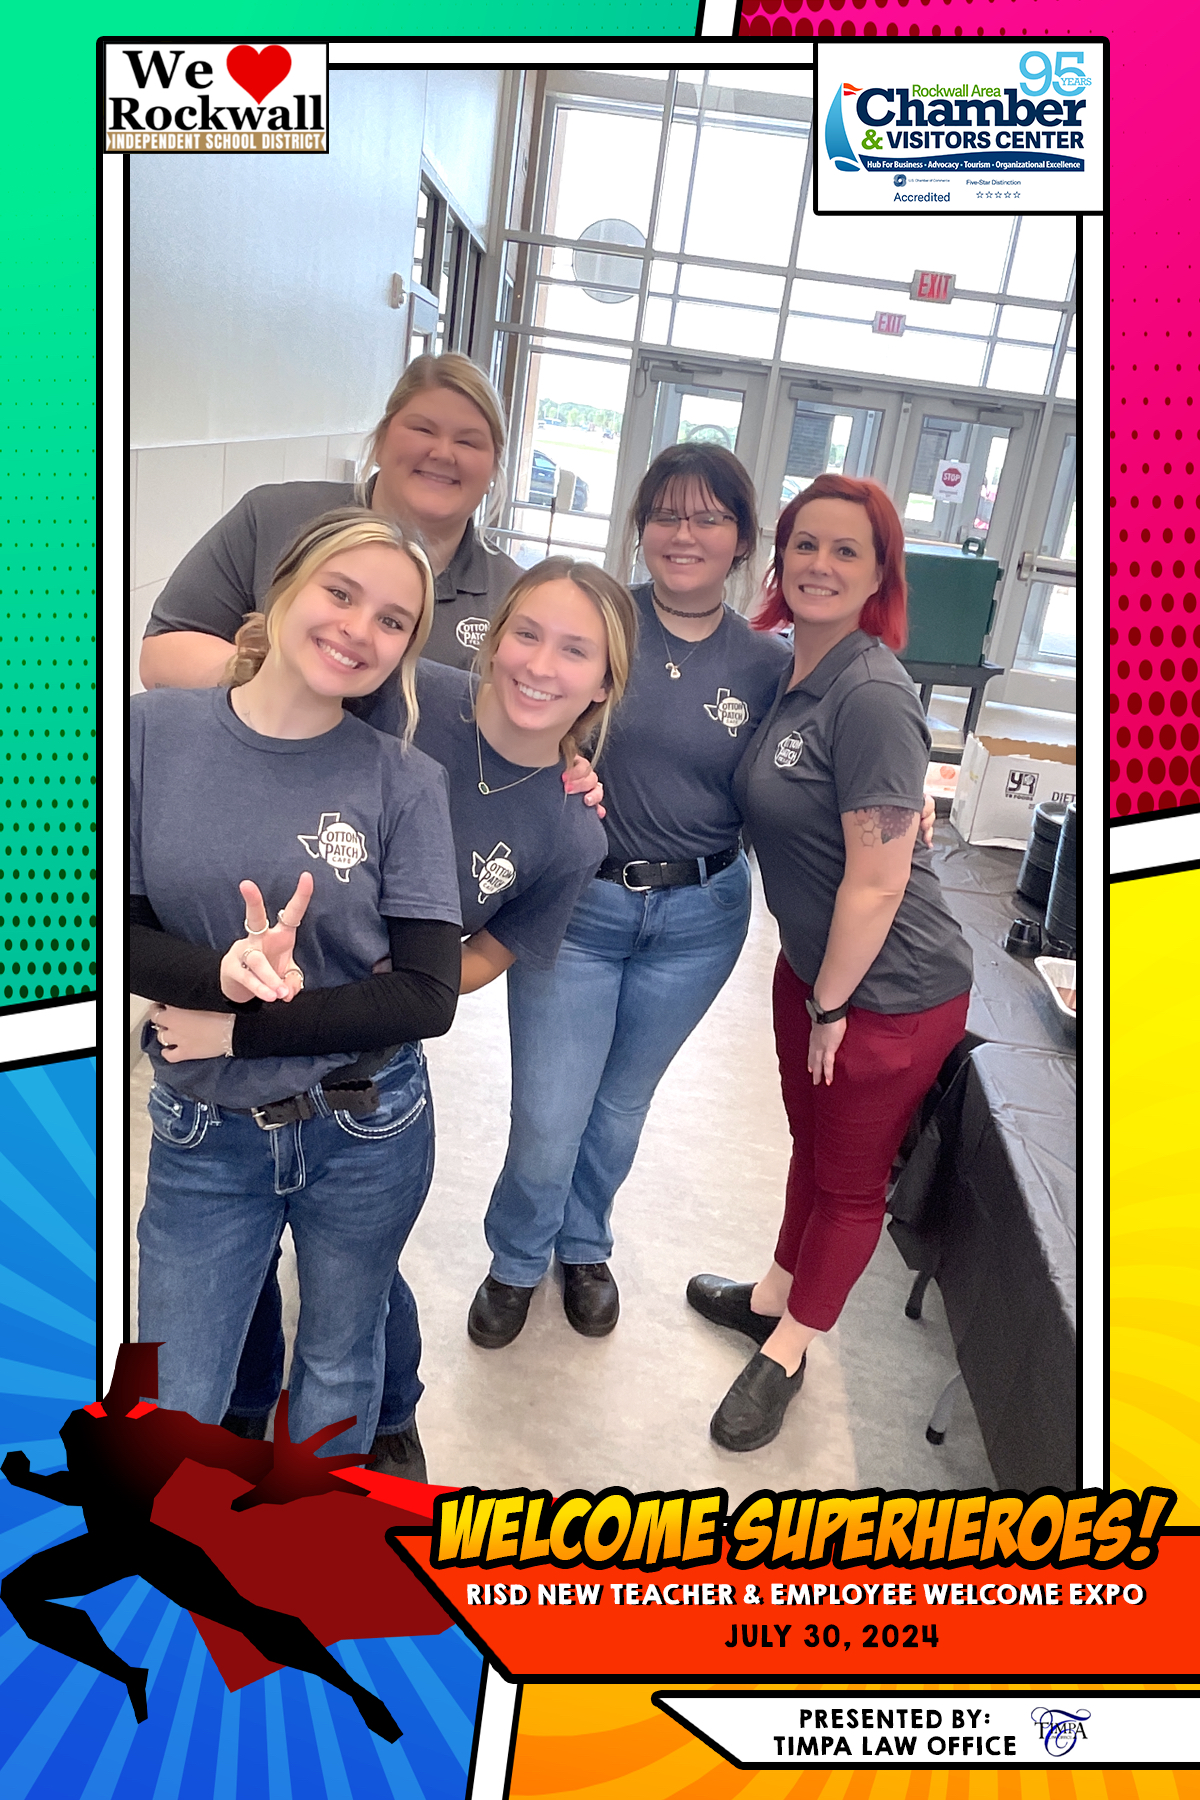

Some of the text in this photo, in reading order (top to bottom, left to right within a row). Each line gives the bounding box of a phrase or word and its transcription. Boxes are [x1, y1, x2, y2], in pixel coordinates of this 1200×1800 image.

[918, 272, 952, 299] EXIT
[878, 313, 903, 333] EXIT
[942, 472, 961, 482] STOP
[463, 632, 486, 645] PATC
[721, 711, 743, 721] PATCH
[320, 829, 358, 845] COTTON
[325, 843, 359, 861] PATCH
